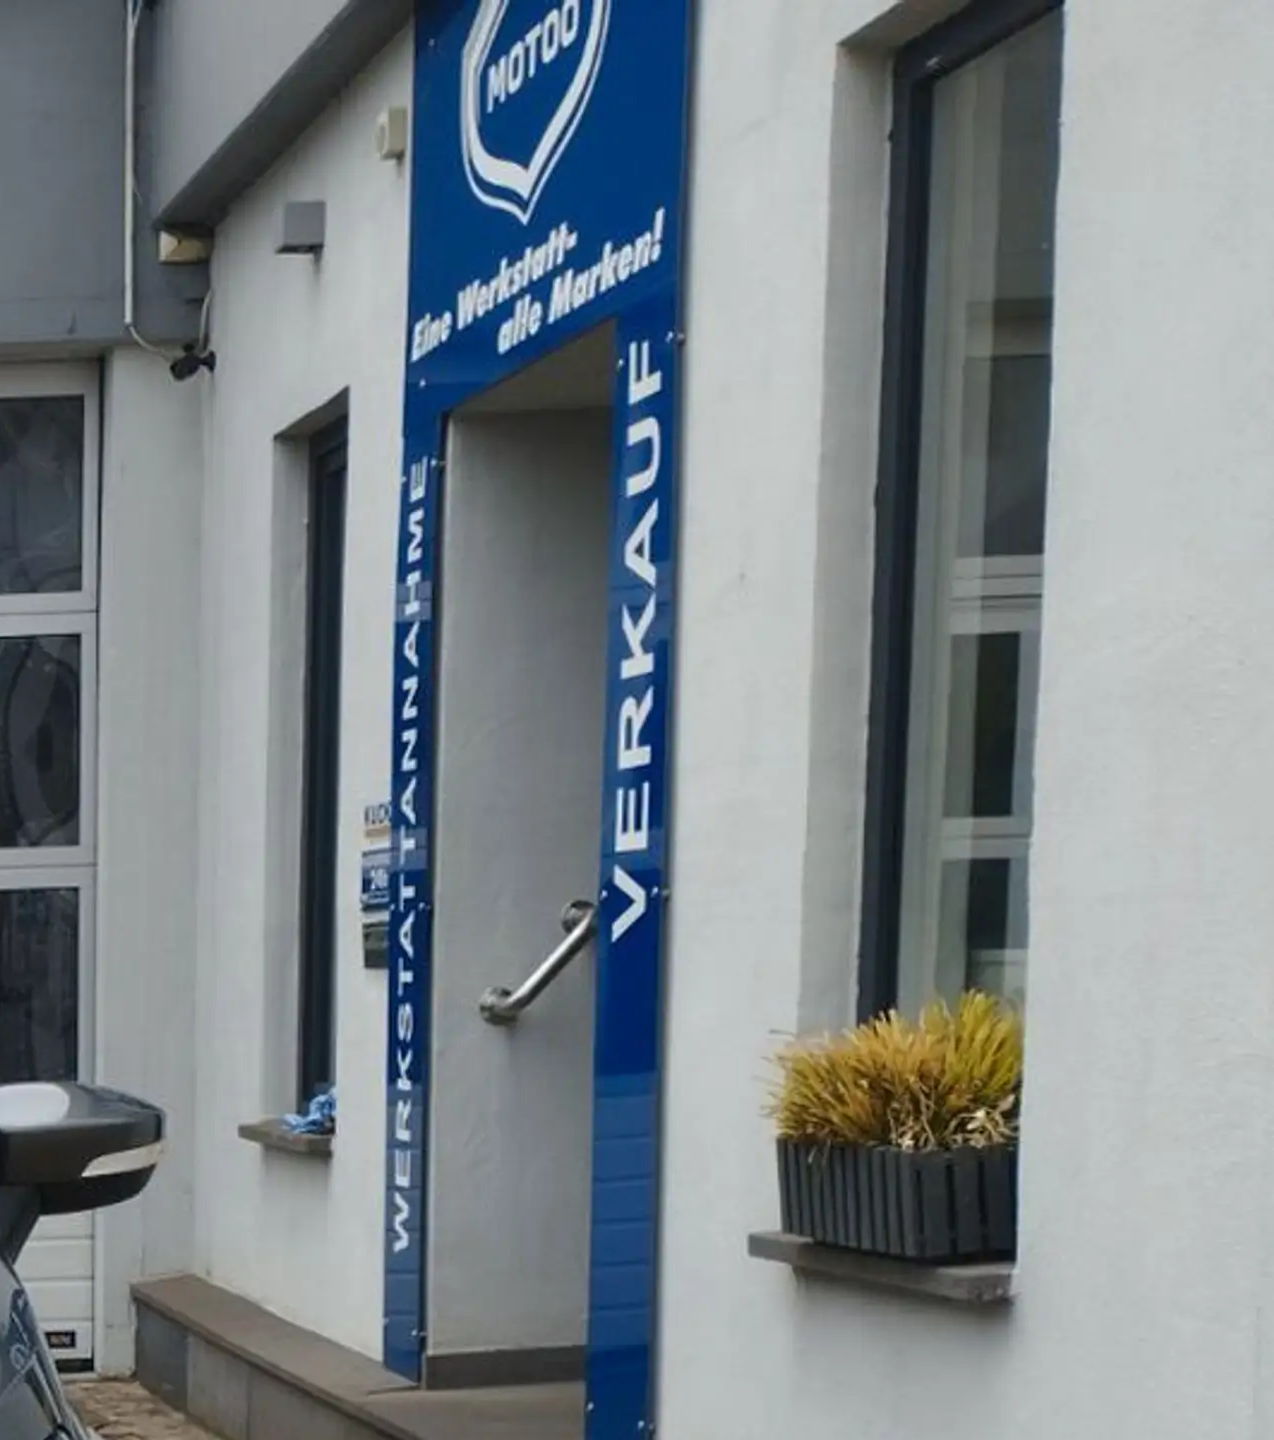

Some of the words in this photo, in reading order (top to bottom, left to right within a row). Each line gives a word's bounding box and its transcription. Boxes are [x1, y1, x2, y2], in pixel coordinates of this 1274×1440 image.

[487, 0, 580, 113] MOTOO
[411, 311, 452, 362] Eine
[457, 221, 578, 330] Werkstatt-
[498, 295, 543, 354] alle
[548, 207, 665, 323] Marken!
[611, 339, 662, 942] VERKAUF
[393, 455, 428, 1252] WERKSTATTANNAHME
